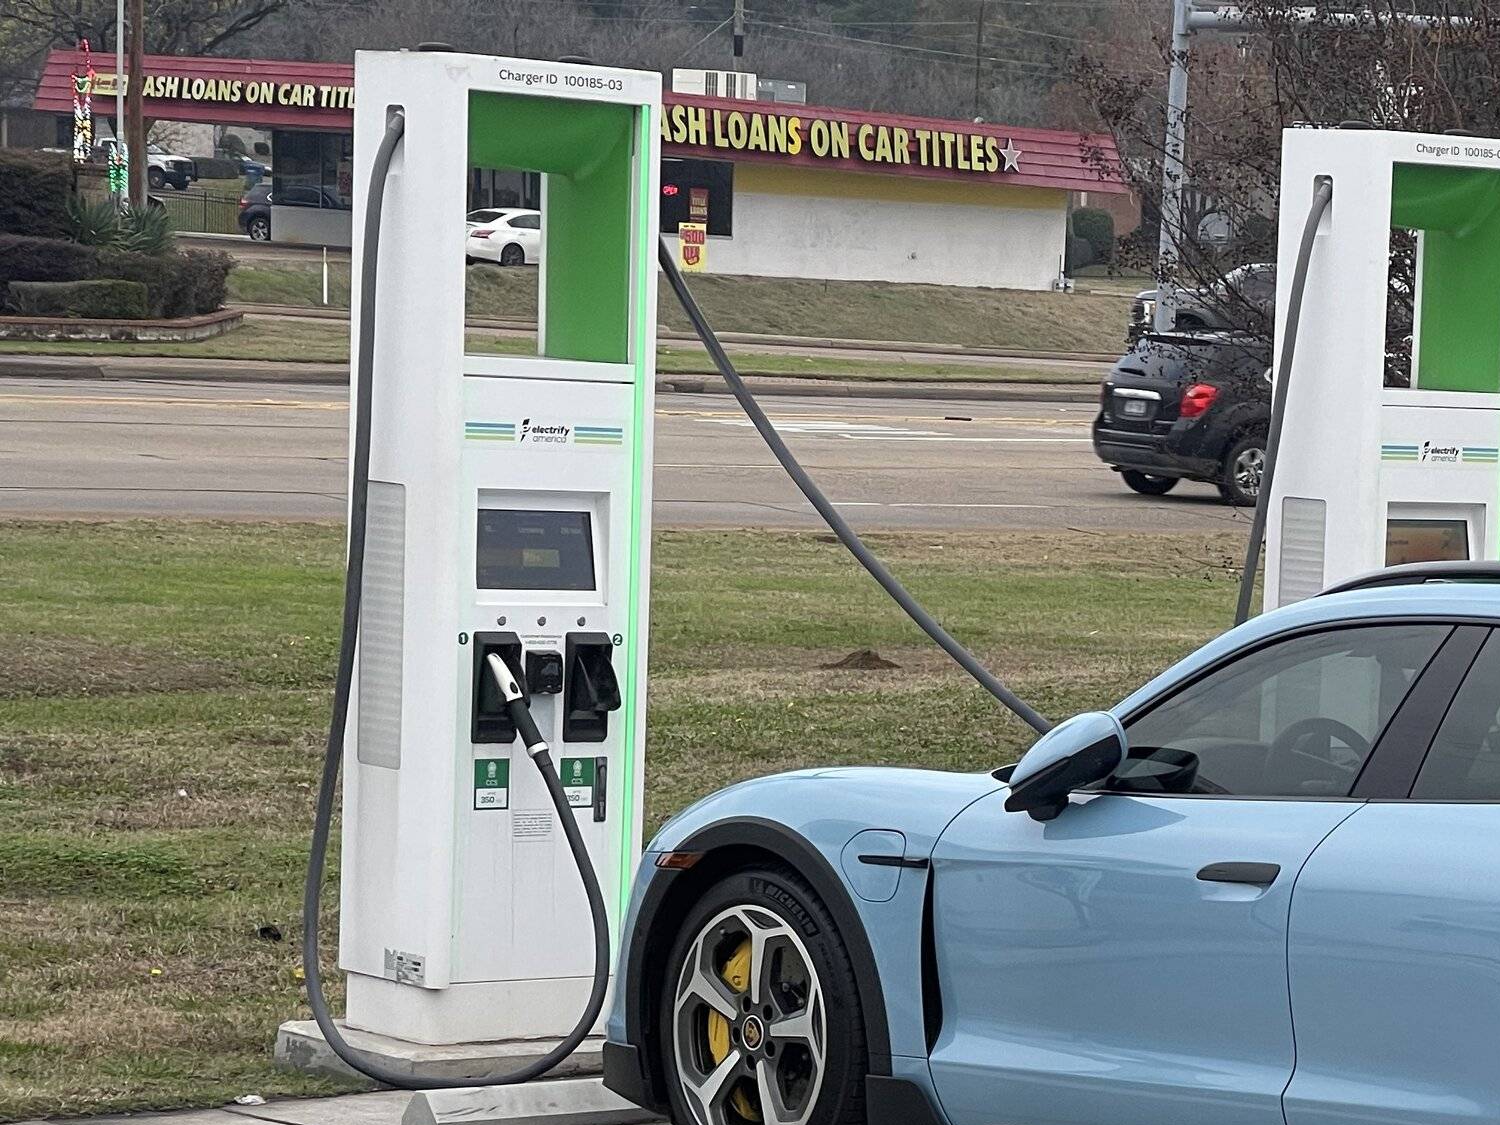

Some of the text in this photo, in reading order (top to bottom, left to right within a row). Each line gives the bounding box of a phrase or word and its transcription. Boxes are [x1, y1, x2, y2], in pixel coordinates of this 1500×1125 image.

[498, 69, 623, 91] Charger ID 100185-03
[142, 75, 180, 98] ASH
[181, 77, 242, 103] LOANS
[245, 80, 275, 104] ON
[278, 83, 315, 107] CAR
[319, 85, 355, 109] TITL
[661, 103, 999, 173] ASH LOANS ON CAR TITLES
[1416, 143, 1449, 157] Charger
[1450, 146, 1460, 156] ID
[531, 425, 570, 437] electrify
[532, 433, 567, 444] america
[1430, 446, 1460, 456] electrify
[1431, 455, 1458, 463] america
